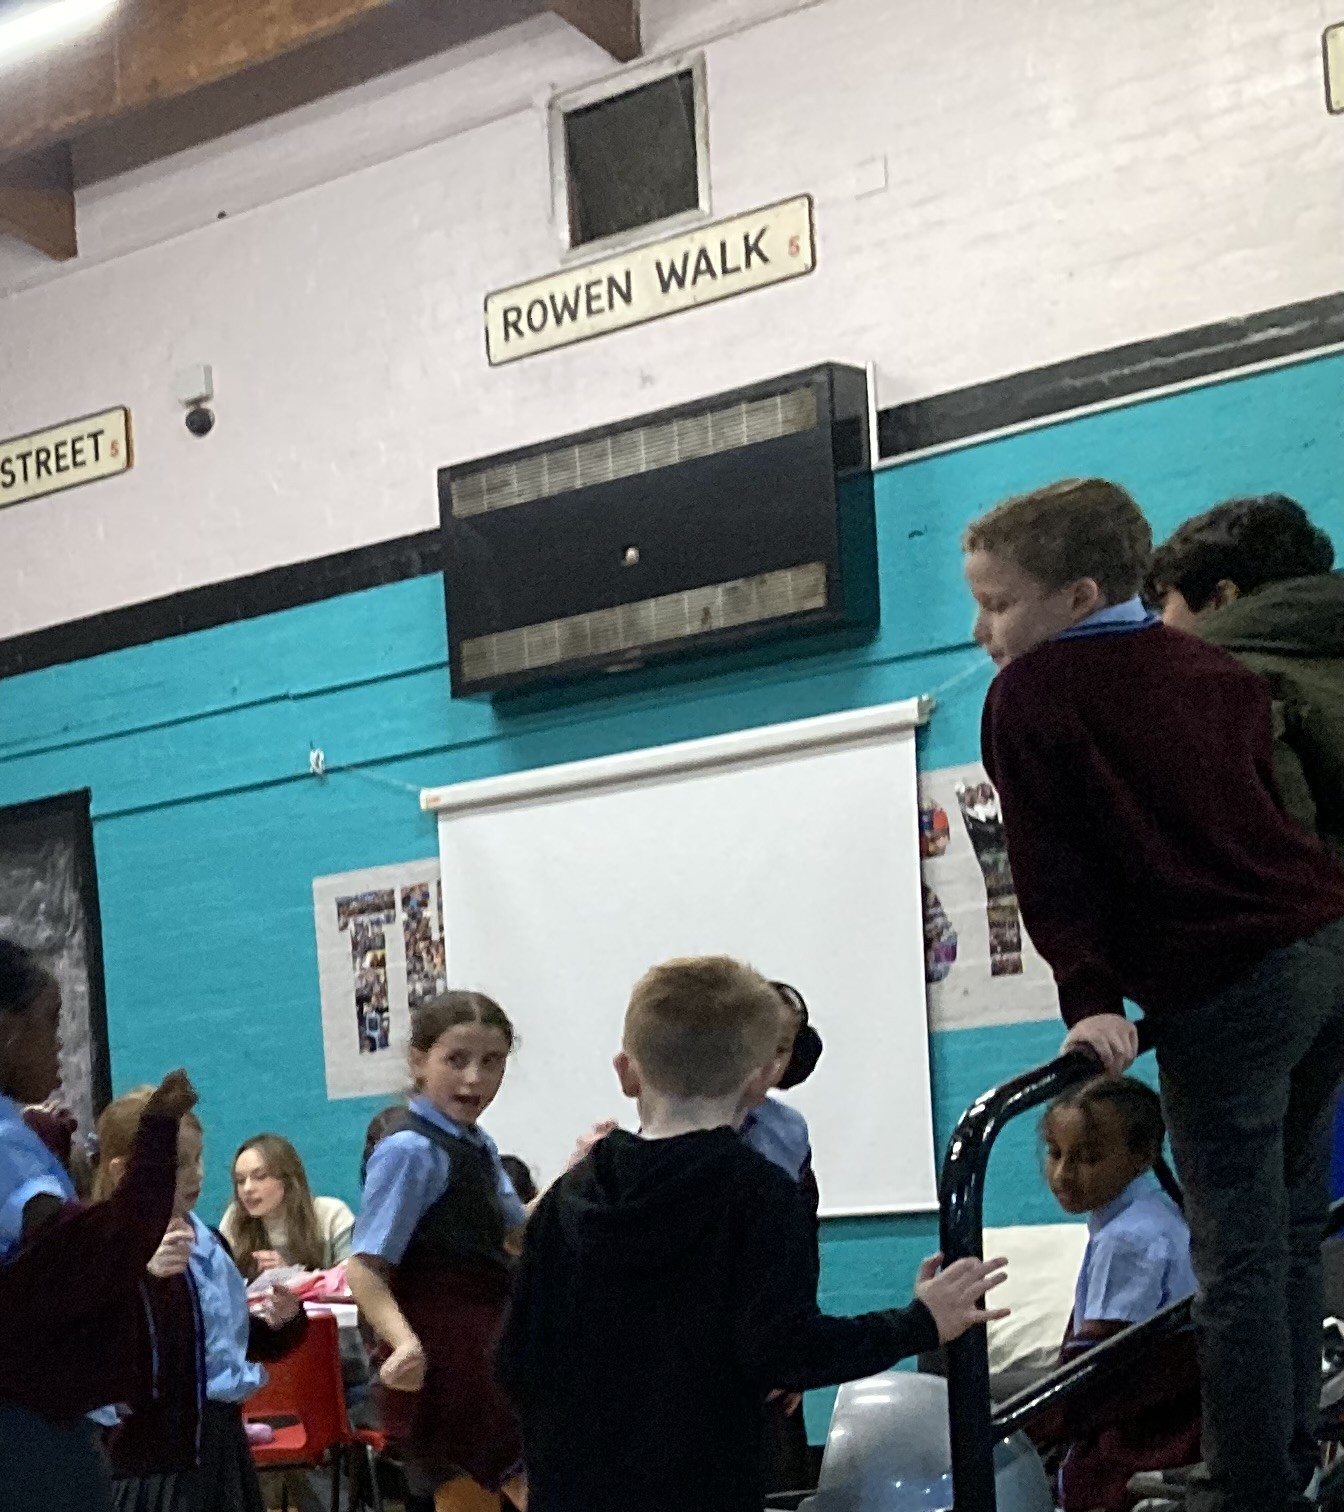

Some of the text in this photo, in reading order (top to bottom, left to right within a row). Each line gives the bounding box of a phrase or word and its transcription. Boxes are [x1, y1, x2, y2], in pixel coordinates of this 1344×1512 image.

[501, 269, 633, 343] ROWEN
[654, 225, 770, 295] WALK
[0, 429, 105, 489] STREET
